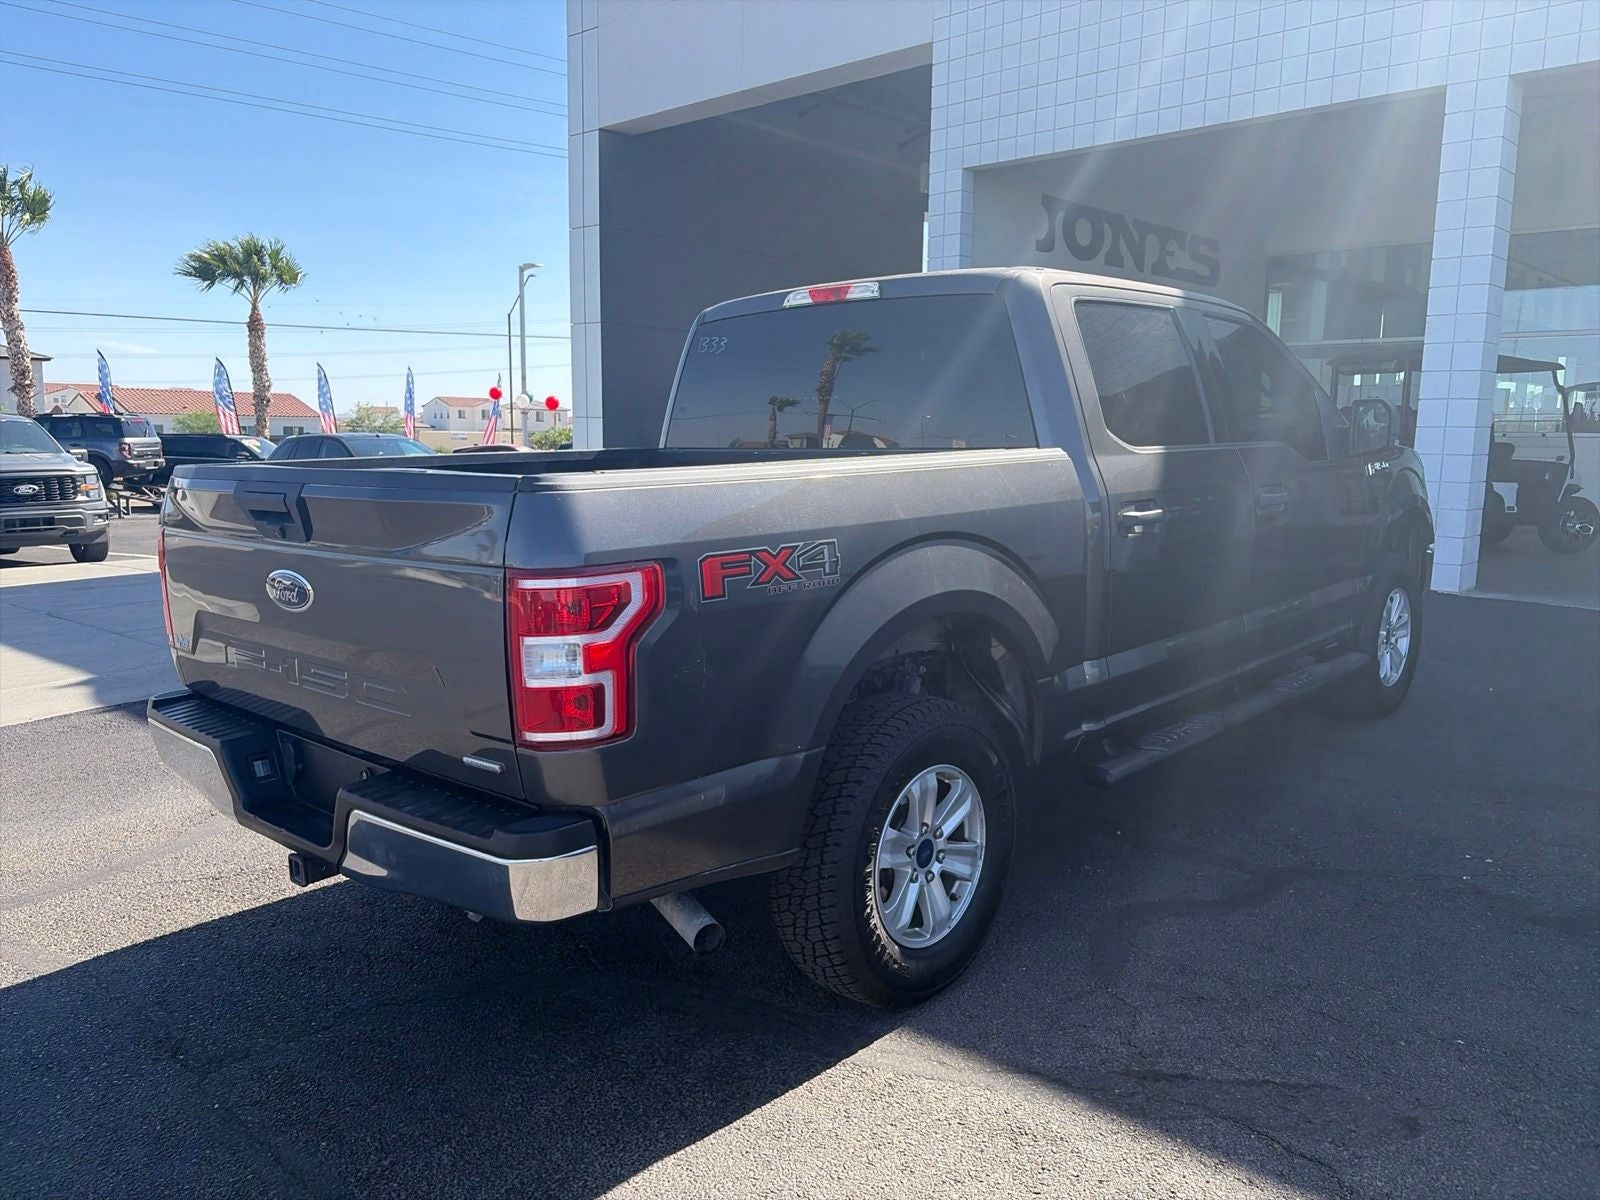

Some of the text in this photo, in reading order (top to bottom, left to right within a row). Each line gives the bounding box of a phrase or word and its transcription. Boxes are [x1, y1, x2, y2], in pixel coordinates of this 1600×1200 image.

[1035, 194, 1221, 288] JONES
[273, 577, 299, 603] Ford
[698, 538, 841, 603] FX4
[766, 576, 841, 596] OFF ROAD
